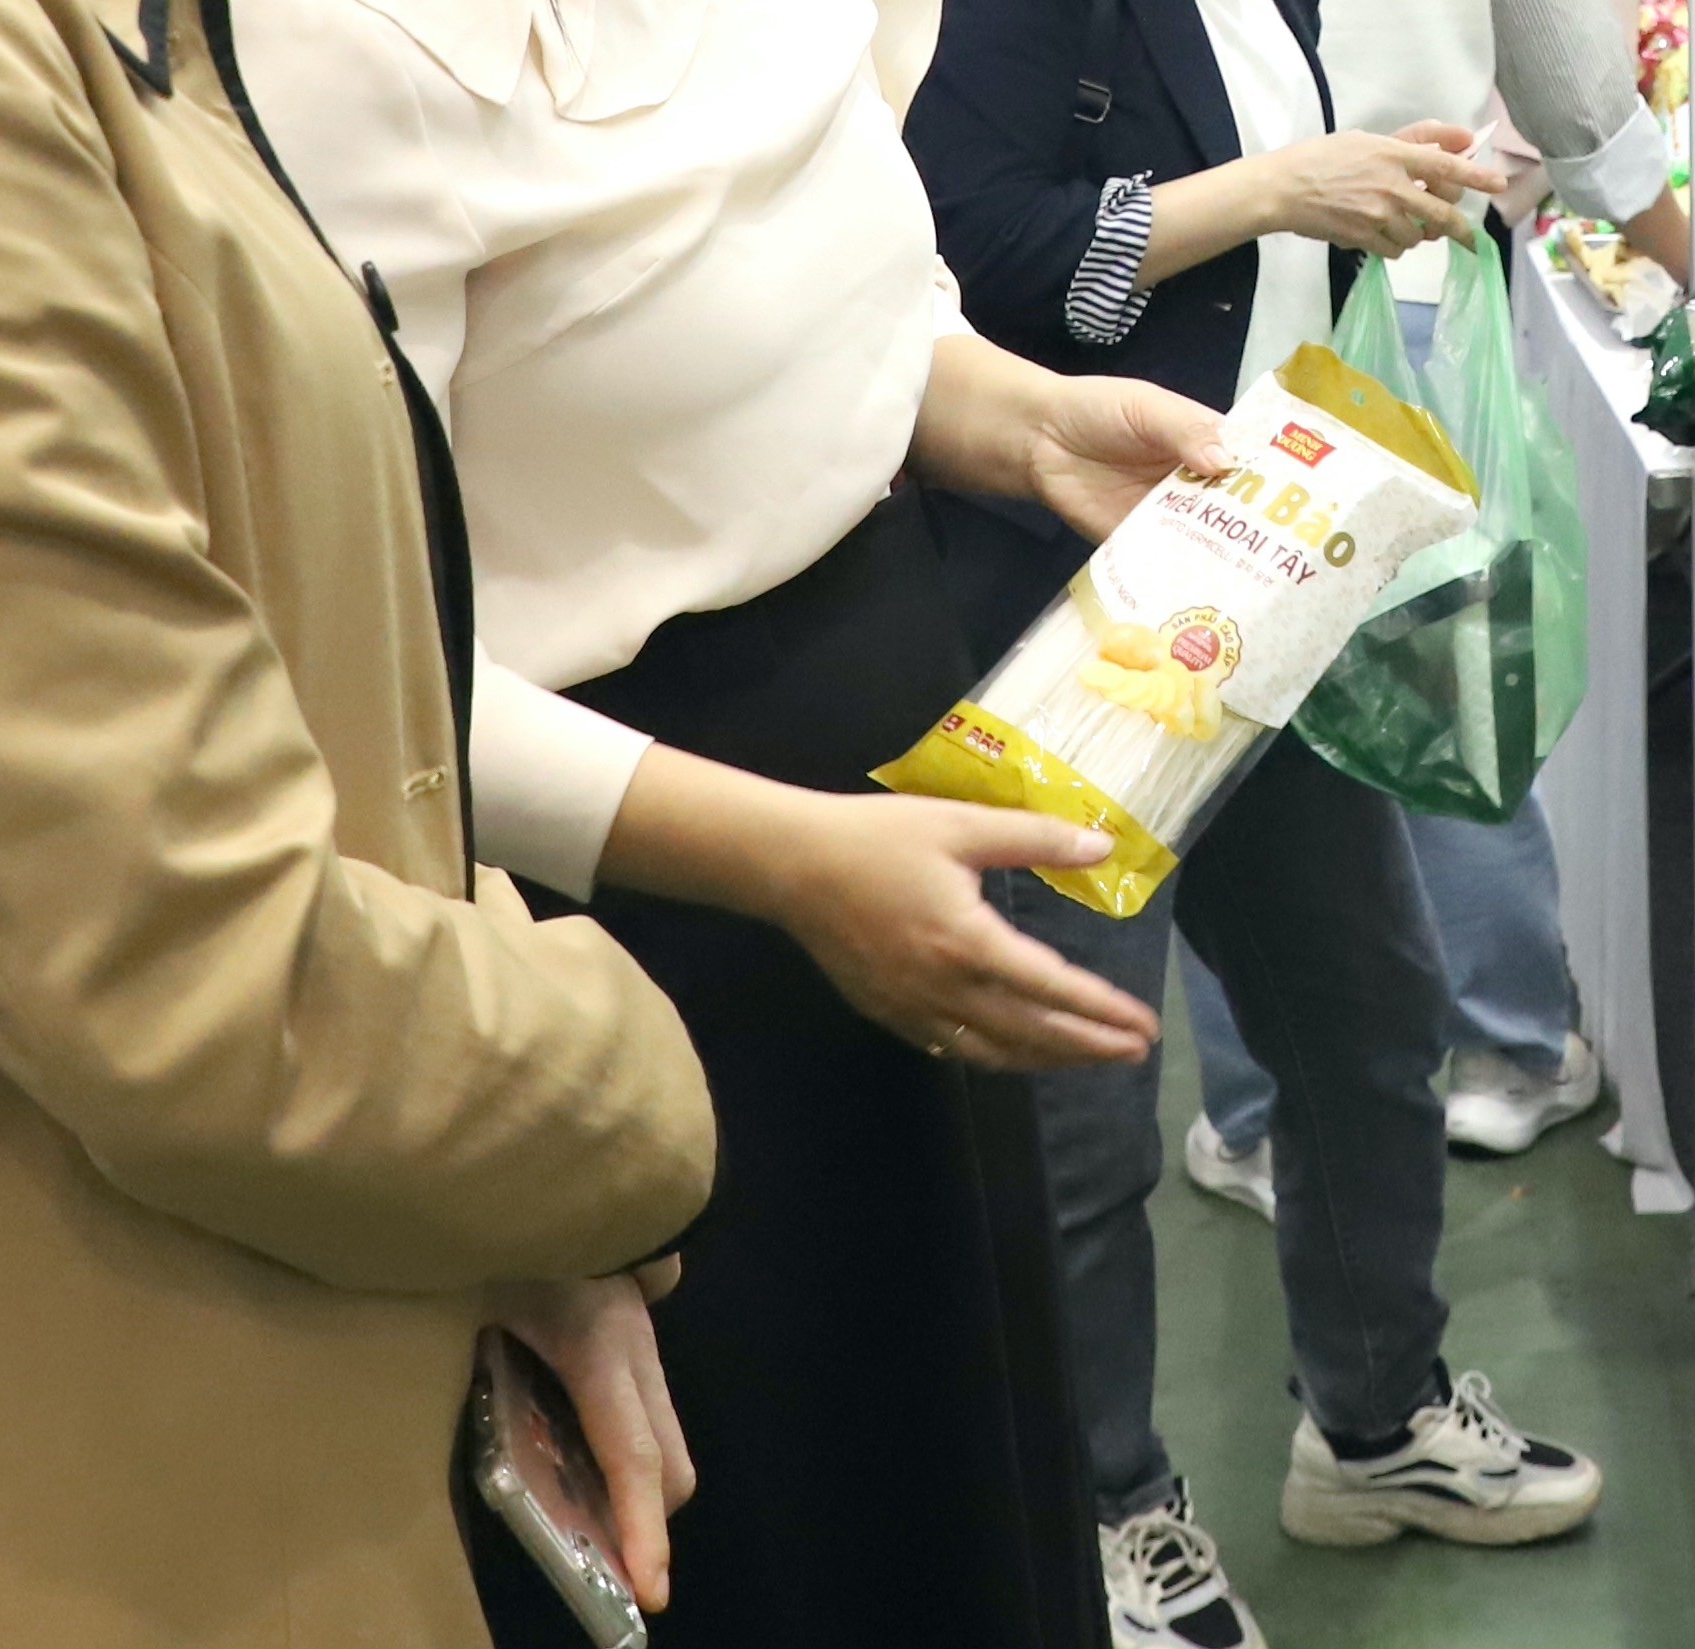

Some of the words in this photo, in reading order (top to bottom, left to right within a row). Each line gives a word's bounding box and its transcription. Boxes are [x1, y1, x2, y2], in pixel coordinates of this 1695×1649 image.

[1292, 429, 1324, 450] MINH
[1198, 503, 1268, 554] KHOAI
[1270, 544, 1316, 585] TÂY
[1262, 482, 1356, 568] Bảo
